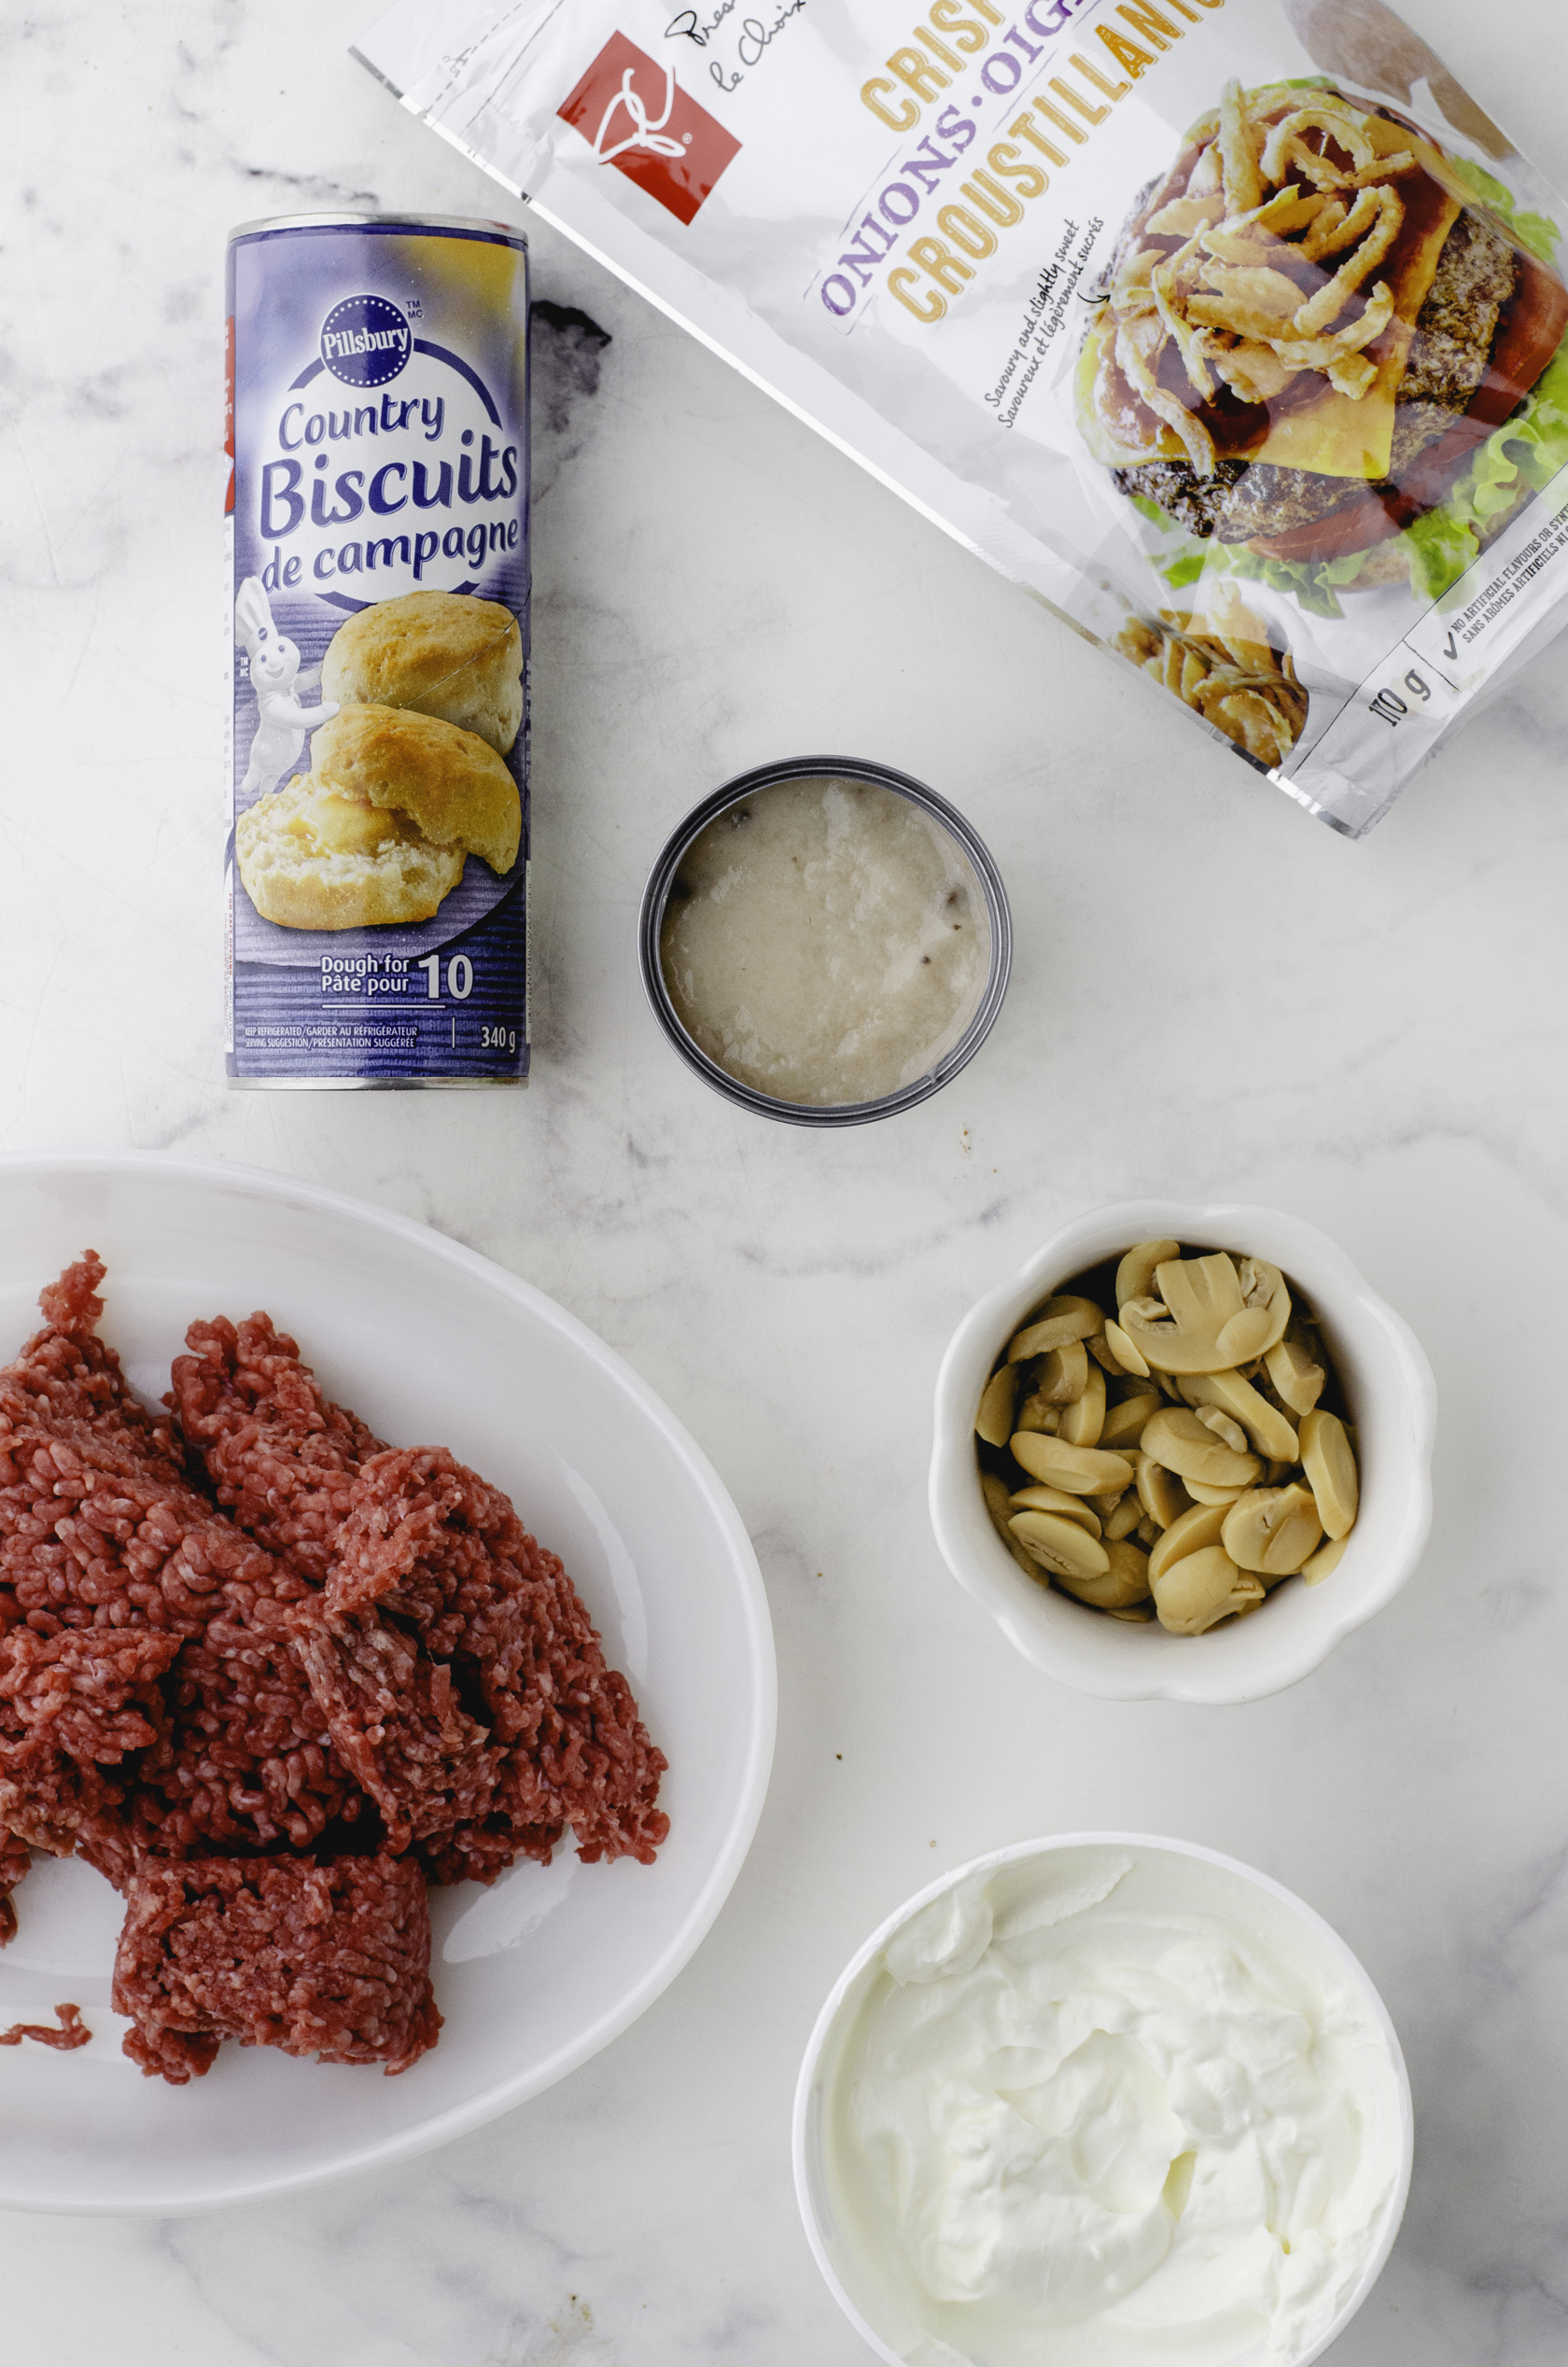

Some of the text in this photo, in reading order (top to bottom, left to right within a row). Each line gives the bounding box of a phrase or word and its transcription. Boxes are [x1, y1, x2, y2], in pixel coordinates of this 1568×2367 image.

[709, 61, 745, 92] le
[820, 0, 1083, 316] ONIONS OIG
[887, 0, 1225, 324] CROUSTILLAN
[406, 300, 421, 310] TM
[407, 310, 423, 319] MC
[985, 218, 1080, 408] Savoury and slightly sweet
[998, 216, 1104, 429] Savoureux et légèrement sucrés
[322, 327, 409, 359] Pillsbury
[278, 393, 445, 453] Country
[259, 428, 518, 540] Biscuits
[260, 518, 519, 595] de campagne
[1450, 618, 1466, 634] NO
[1463, 577, 1507, 623] ARTIFICIAL
[1502, 539, 1543, 581] FLAVOURS
[1538, 527, 1553, 542] OR
[1463, 619, 1486, 643] SANS
[1511, 542, 1560, 593] ARTIFICIELS
[1404, 668, 1432, 702] g
[321, 952, 410, 977] Dough for
[418, 954, 473, 1000] 10
[321, 974, 410, 996] Pâte pour
[245, 1038, 267, 1047] SERVING
[373, 1036, 415, 1047] SUGGÉRÉE
[339, 1027, 352, 1036] AU
[354, 1025, 417, 1036] RÉFRIGÉRATEUR
[481, 1027, 516, 1054] 340 g
